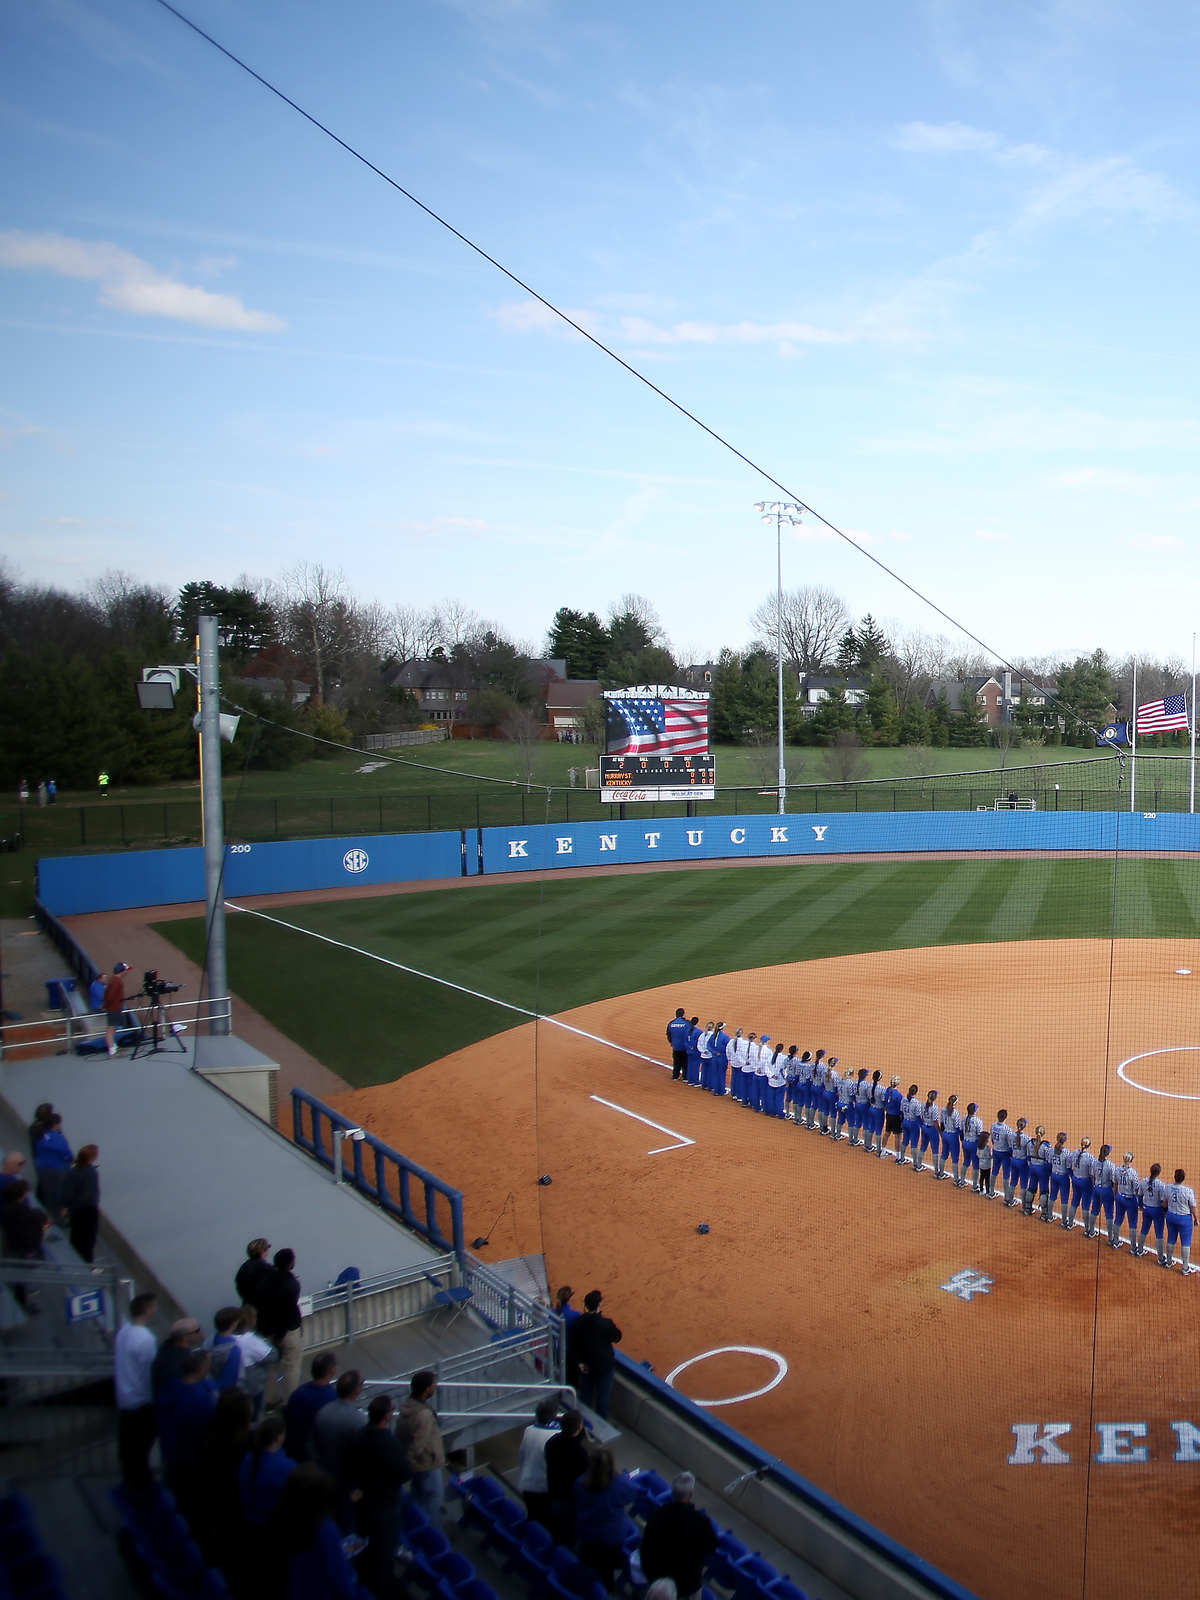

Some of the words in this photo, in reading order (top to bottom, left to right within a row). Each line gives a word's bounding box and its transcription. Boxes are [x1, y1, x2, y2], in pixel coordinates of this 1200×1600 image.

[641, 761, 647, 769] 0
[230, 844, 251, 854] 200
[508, 825, 828, 858] KENTUCKY
[345, 850, 367, 871] SEC
[993, 1131, 1000, 1141] 33
[71, 1291, 99, 1317] G
